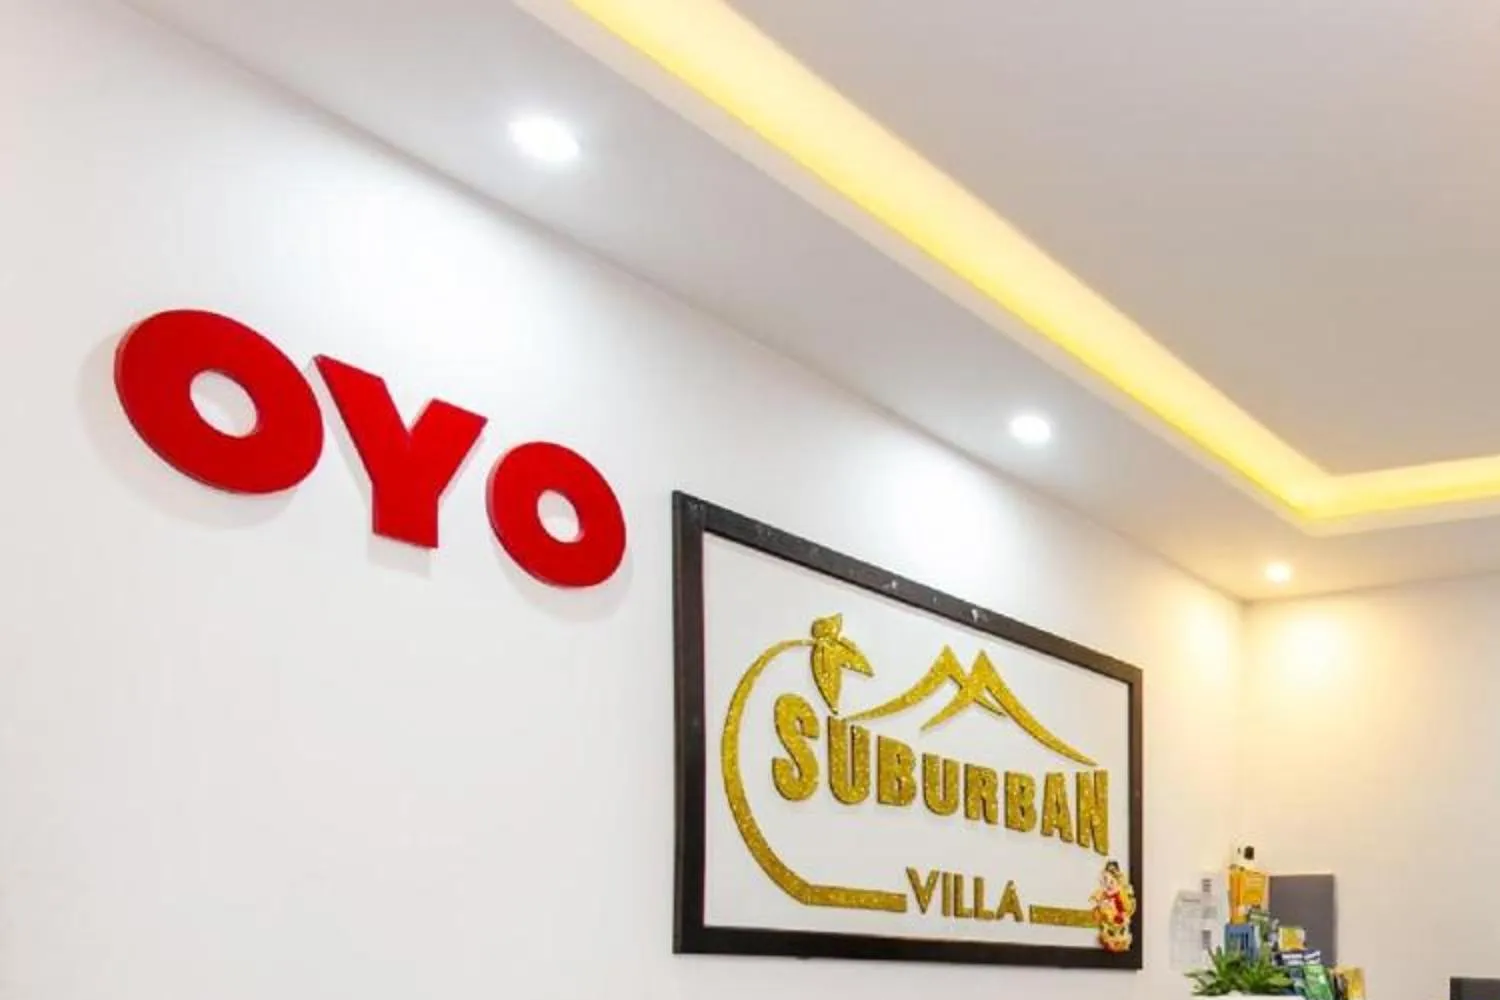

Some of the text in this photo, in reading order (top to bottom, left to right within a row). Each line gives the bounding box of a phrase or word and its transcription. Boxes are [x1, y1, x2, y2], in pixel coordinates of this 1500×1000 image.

[115, 310, 626, 588] OYO
[772, 693, 1109, 855] SUBURBAN
[905, 868, 1026, 925] VILLA
